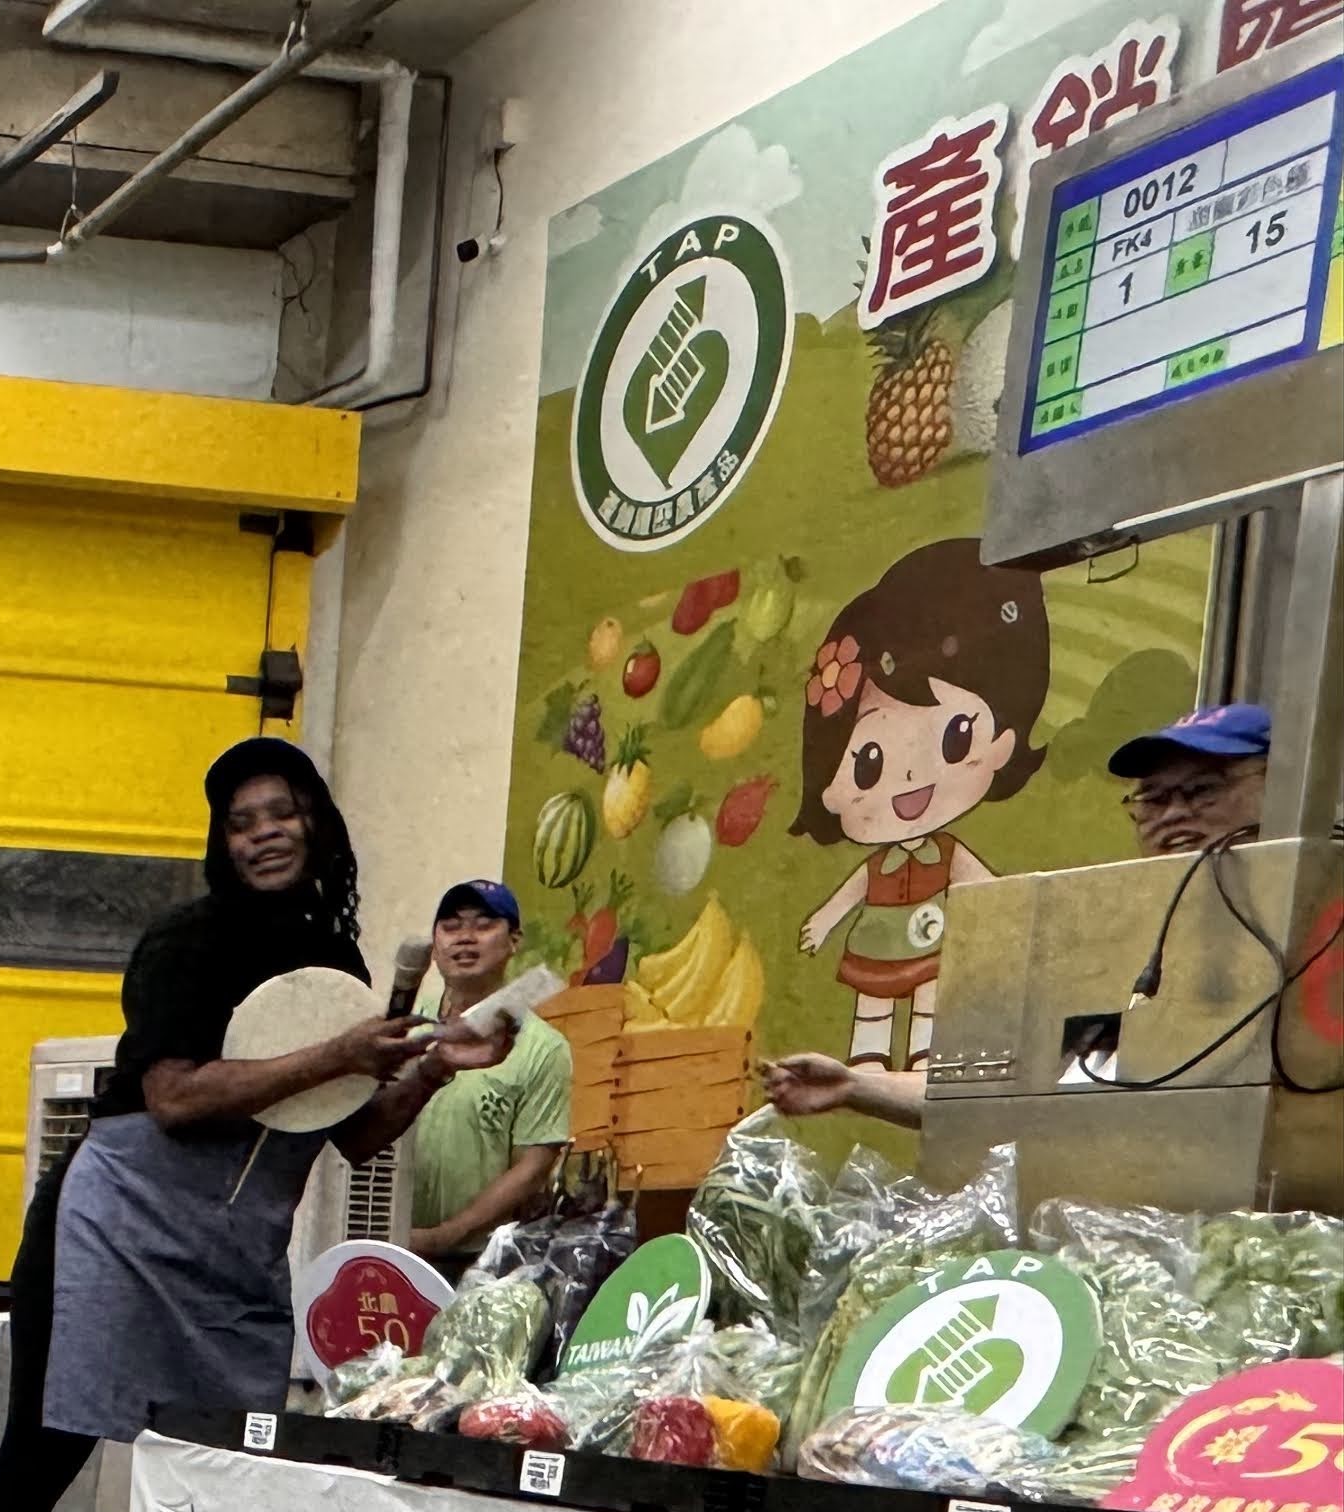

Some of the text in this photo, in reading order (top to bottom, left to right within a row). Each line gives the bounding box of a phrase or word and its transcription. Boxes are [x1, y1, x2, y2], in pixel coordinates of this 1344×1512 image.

[1123, 162, 1198, 218] 0012
[640, 224, 740, 282] TAP
[1246, 210, 1289, 253] 15
[1118, 272, 1134, 304] 1
[917, 1256, 1044, 1294] TAP
[1239, 1422, 1344, 1479] 5
